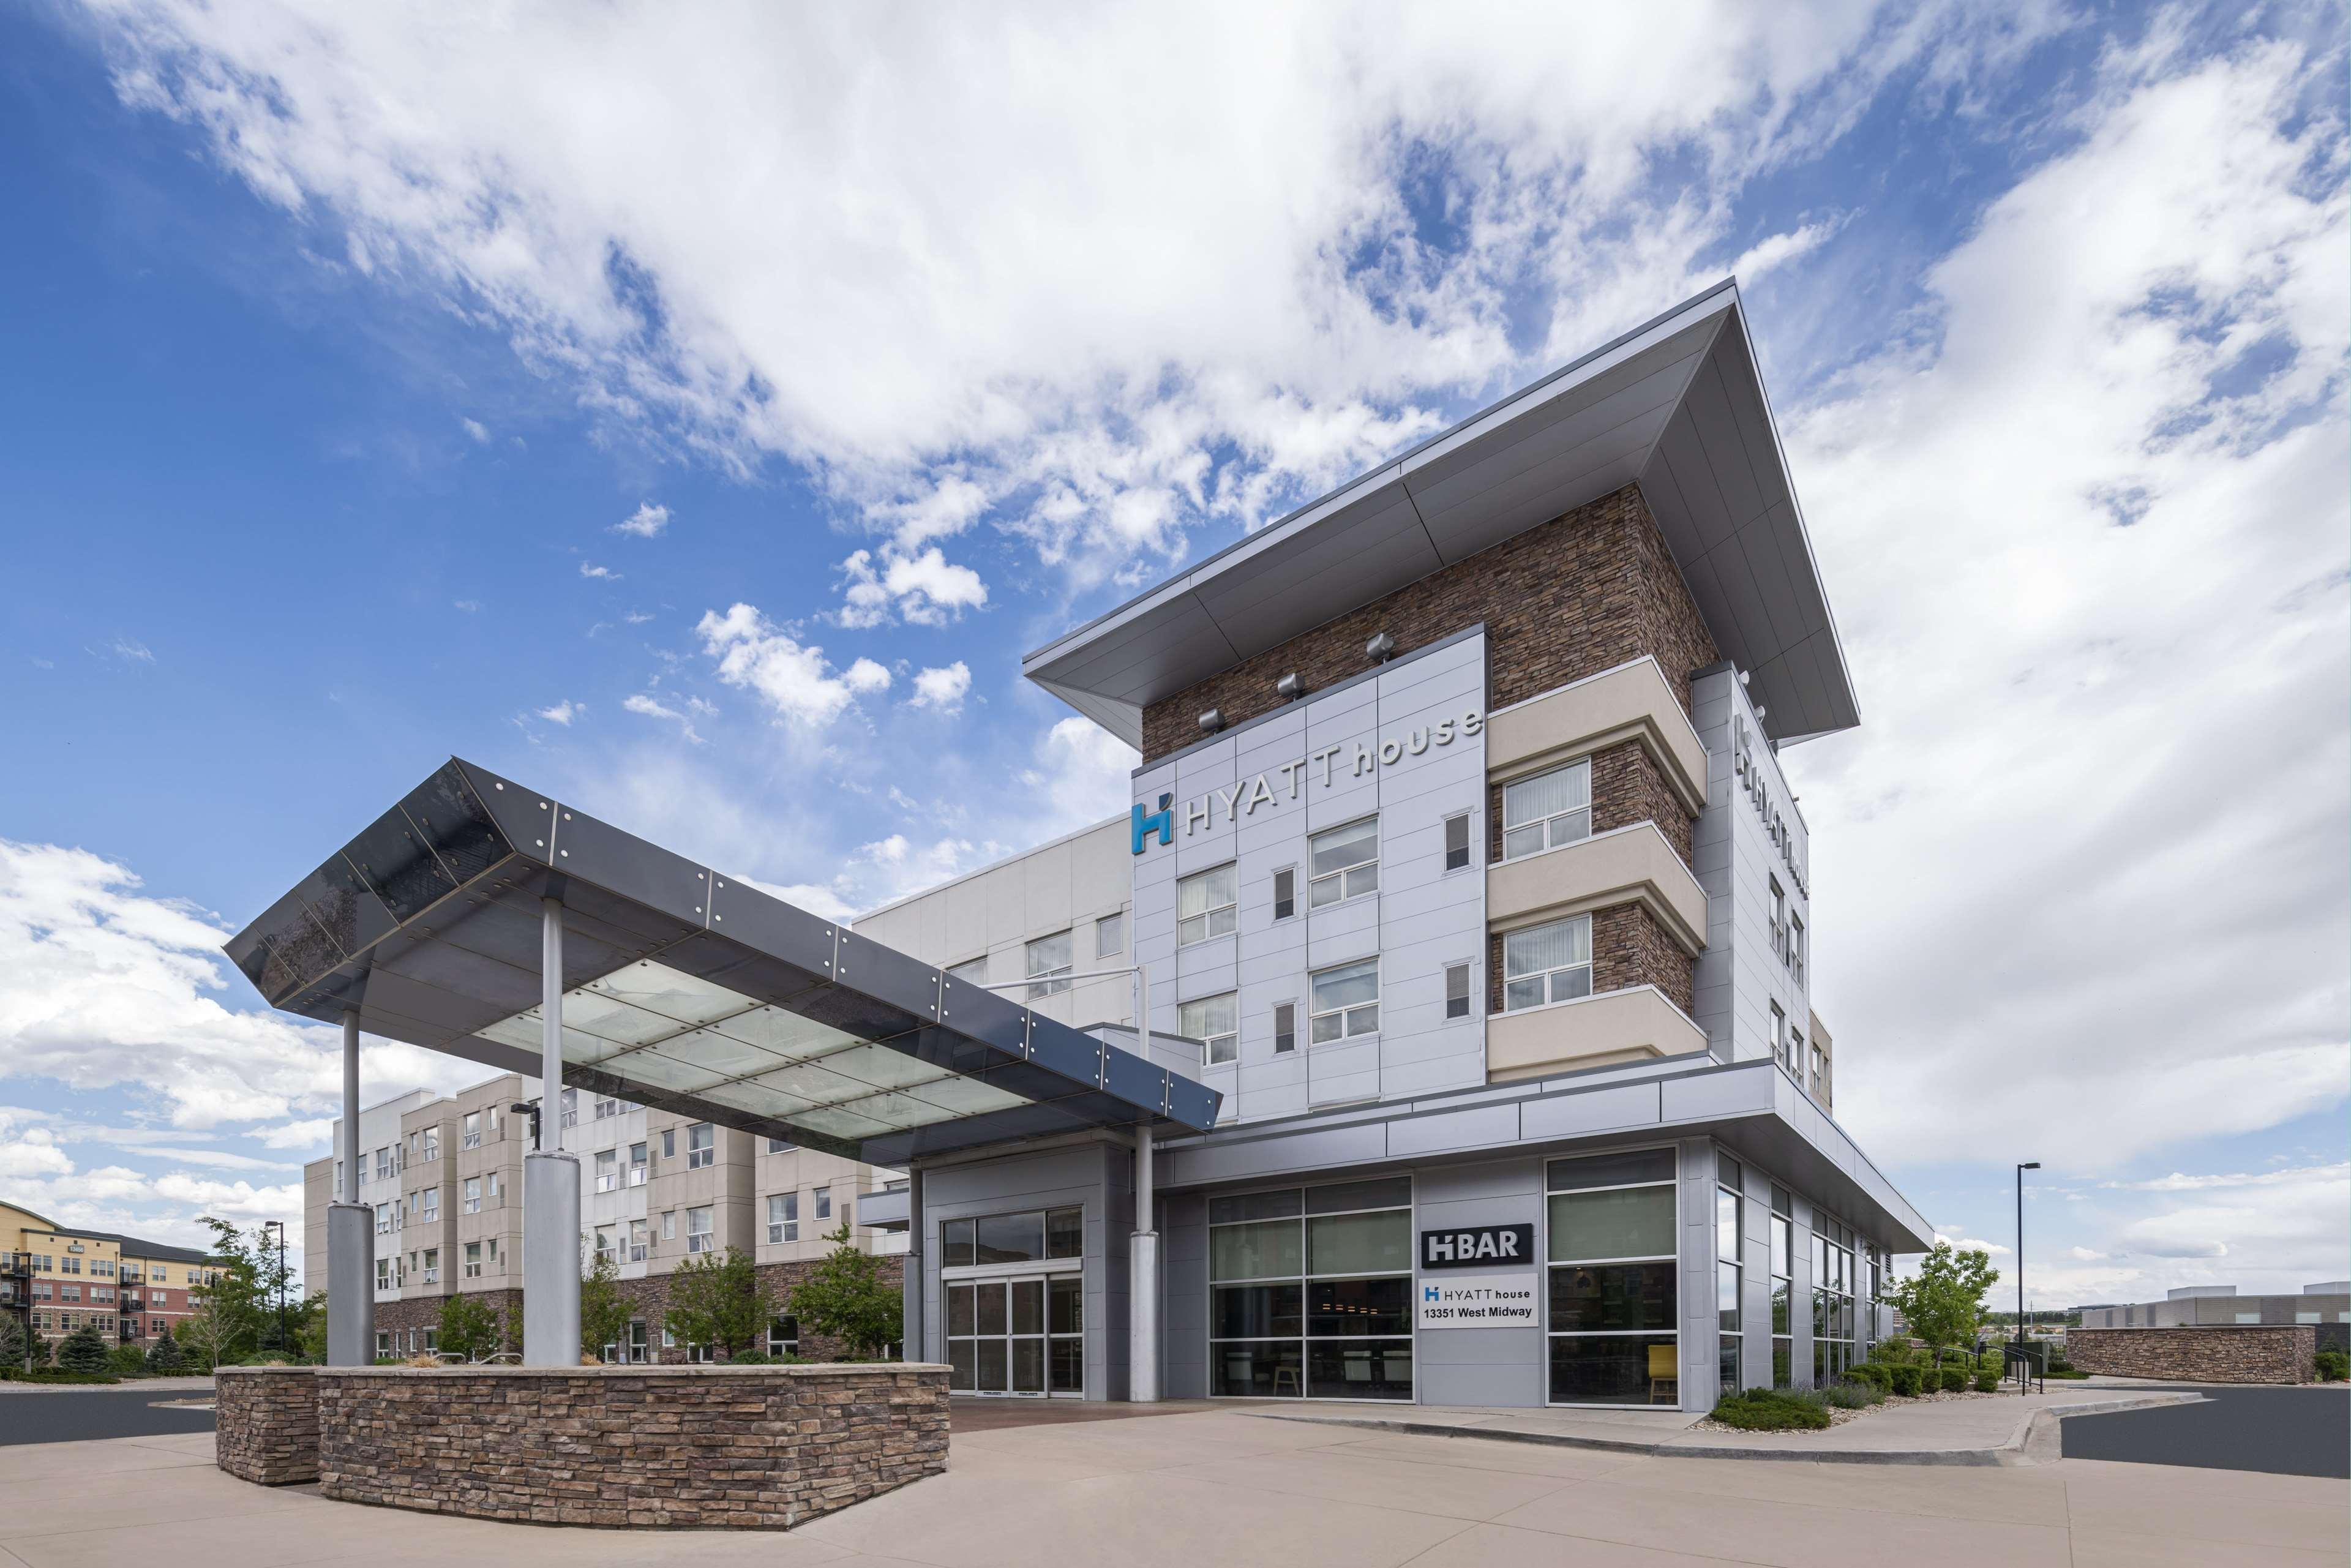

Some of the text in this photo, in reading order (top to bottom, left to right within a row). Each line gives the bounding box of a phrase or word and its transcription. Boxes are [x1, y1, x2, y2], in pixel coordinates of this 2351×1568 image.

[1186, 745, 1341, 836] HYATT
[1353, 708, 1483, 778] house
[1444, 1289, 1492, 1301] HYATT
[1495, 1289, 1531, 1299] house
[1424, 1306, 1532, 1318] 13351 West Midway
